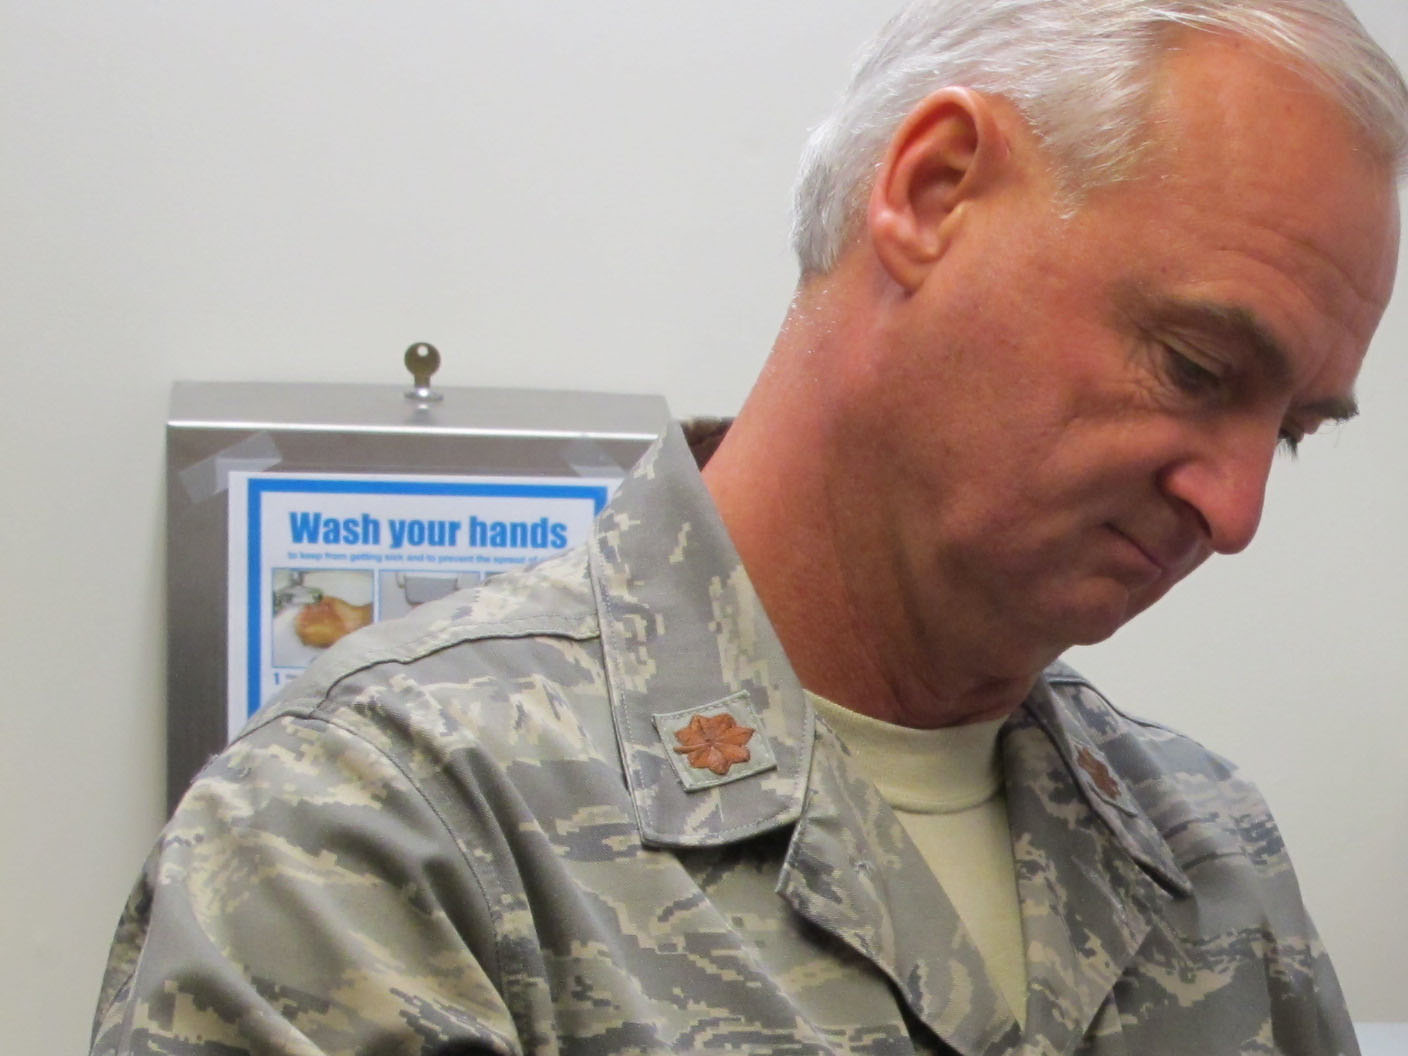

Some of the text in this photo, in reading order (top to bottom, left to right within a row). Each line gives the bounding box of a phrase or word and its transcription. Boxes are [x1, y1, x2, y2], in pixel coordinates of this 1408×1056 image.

[289, 511, 568, 549] Wash your hands
[350, 553, 382, 563] getting
